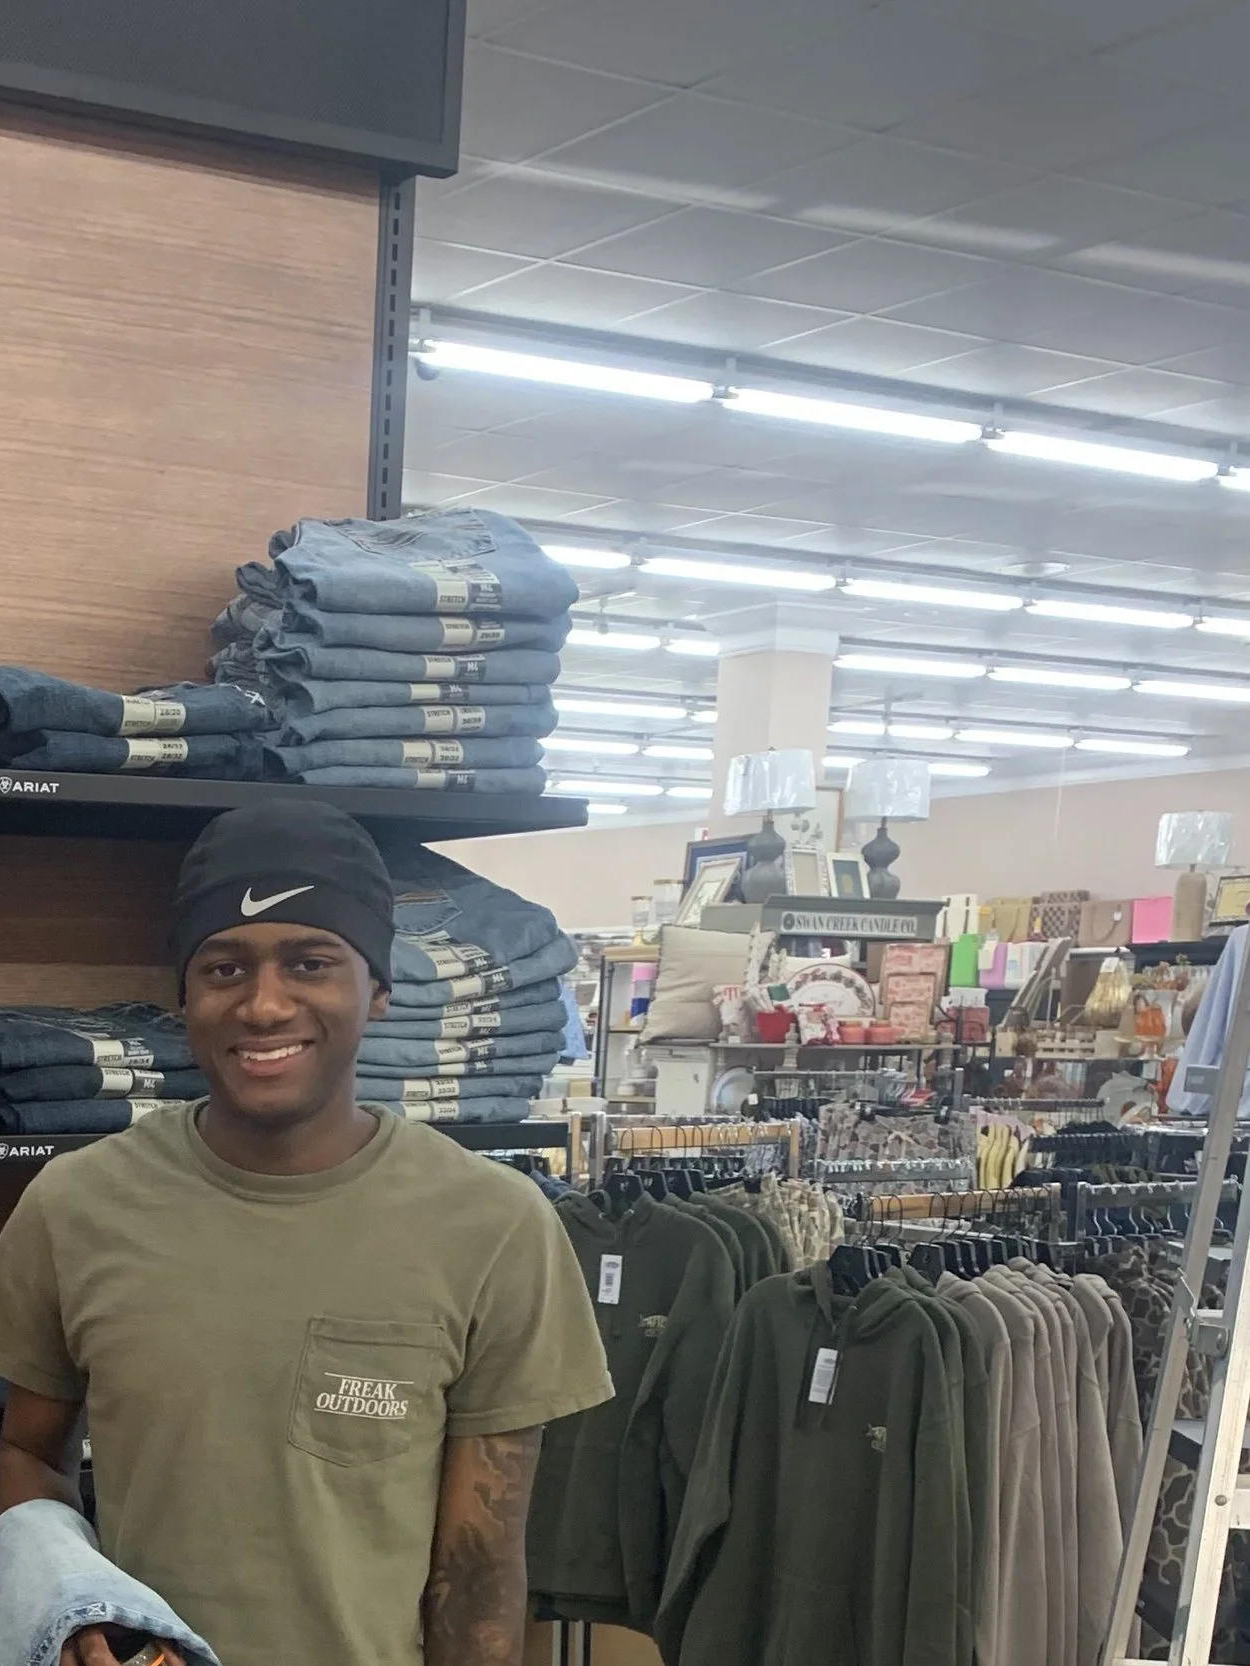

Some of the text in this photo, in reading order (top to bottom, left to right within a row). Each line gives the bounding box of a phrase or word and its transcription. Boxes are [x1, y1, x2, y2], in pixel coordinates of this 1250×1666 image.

[426, 709, 451, 718] STRETCH
[12, 781, 60, 793] ARIAT
[796, 915, 824, 931] SWAN
[826, 915, 858, 932] CREEK
[860, 917, 897, 933] CANDLE
[9, 1145, 55, 1157] ARIAT
[338, 1378, 398, 1400] FREAK
[316, 1392, 409, 1416] OUTDOORS
